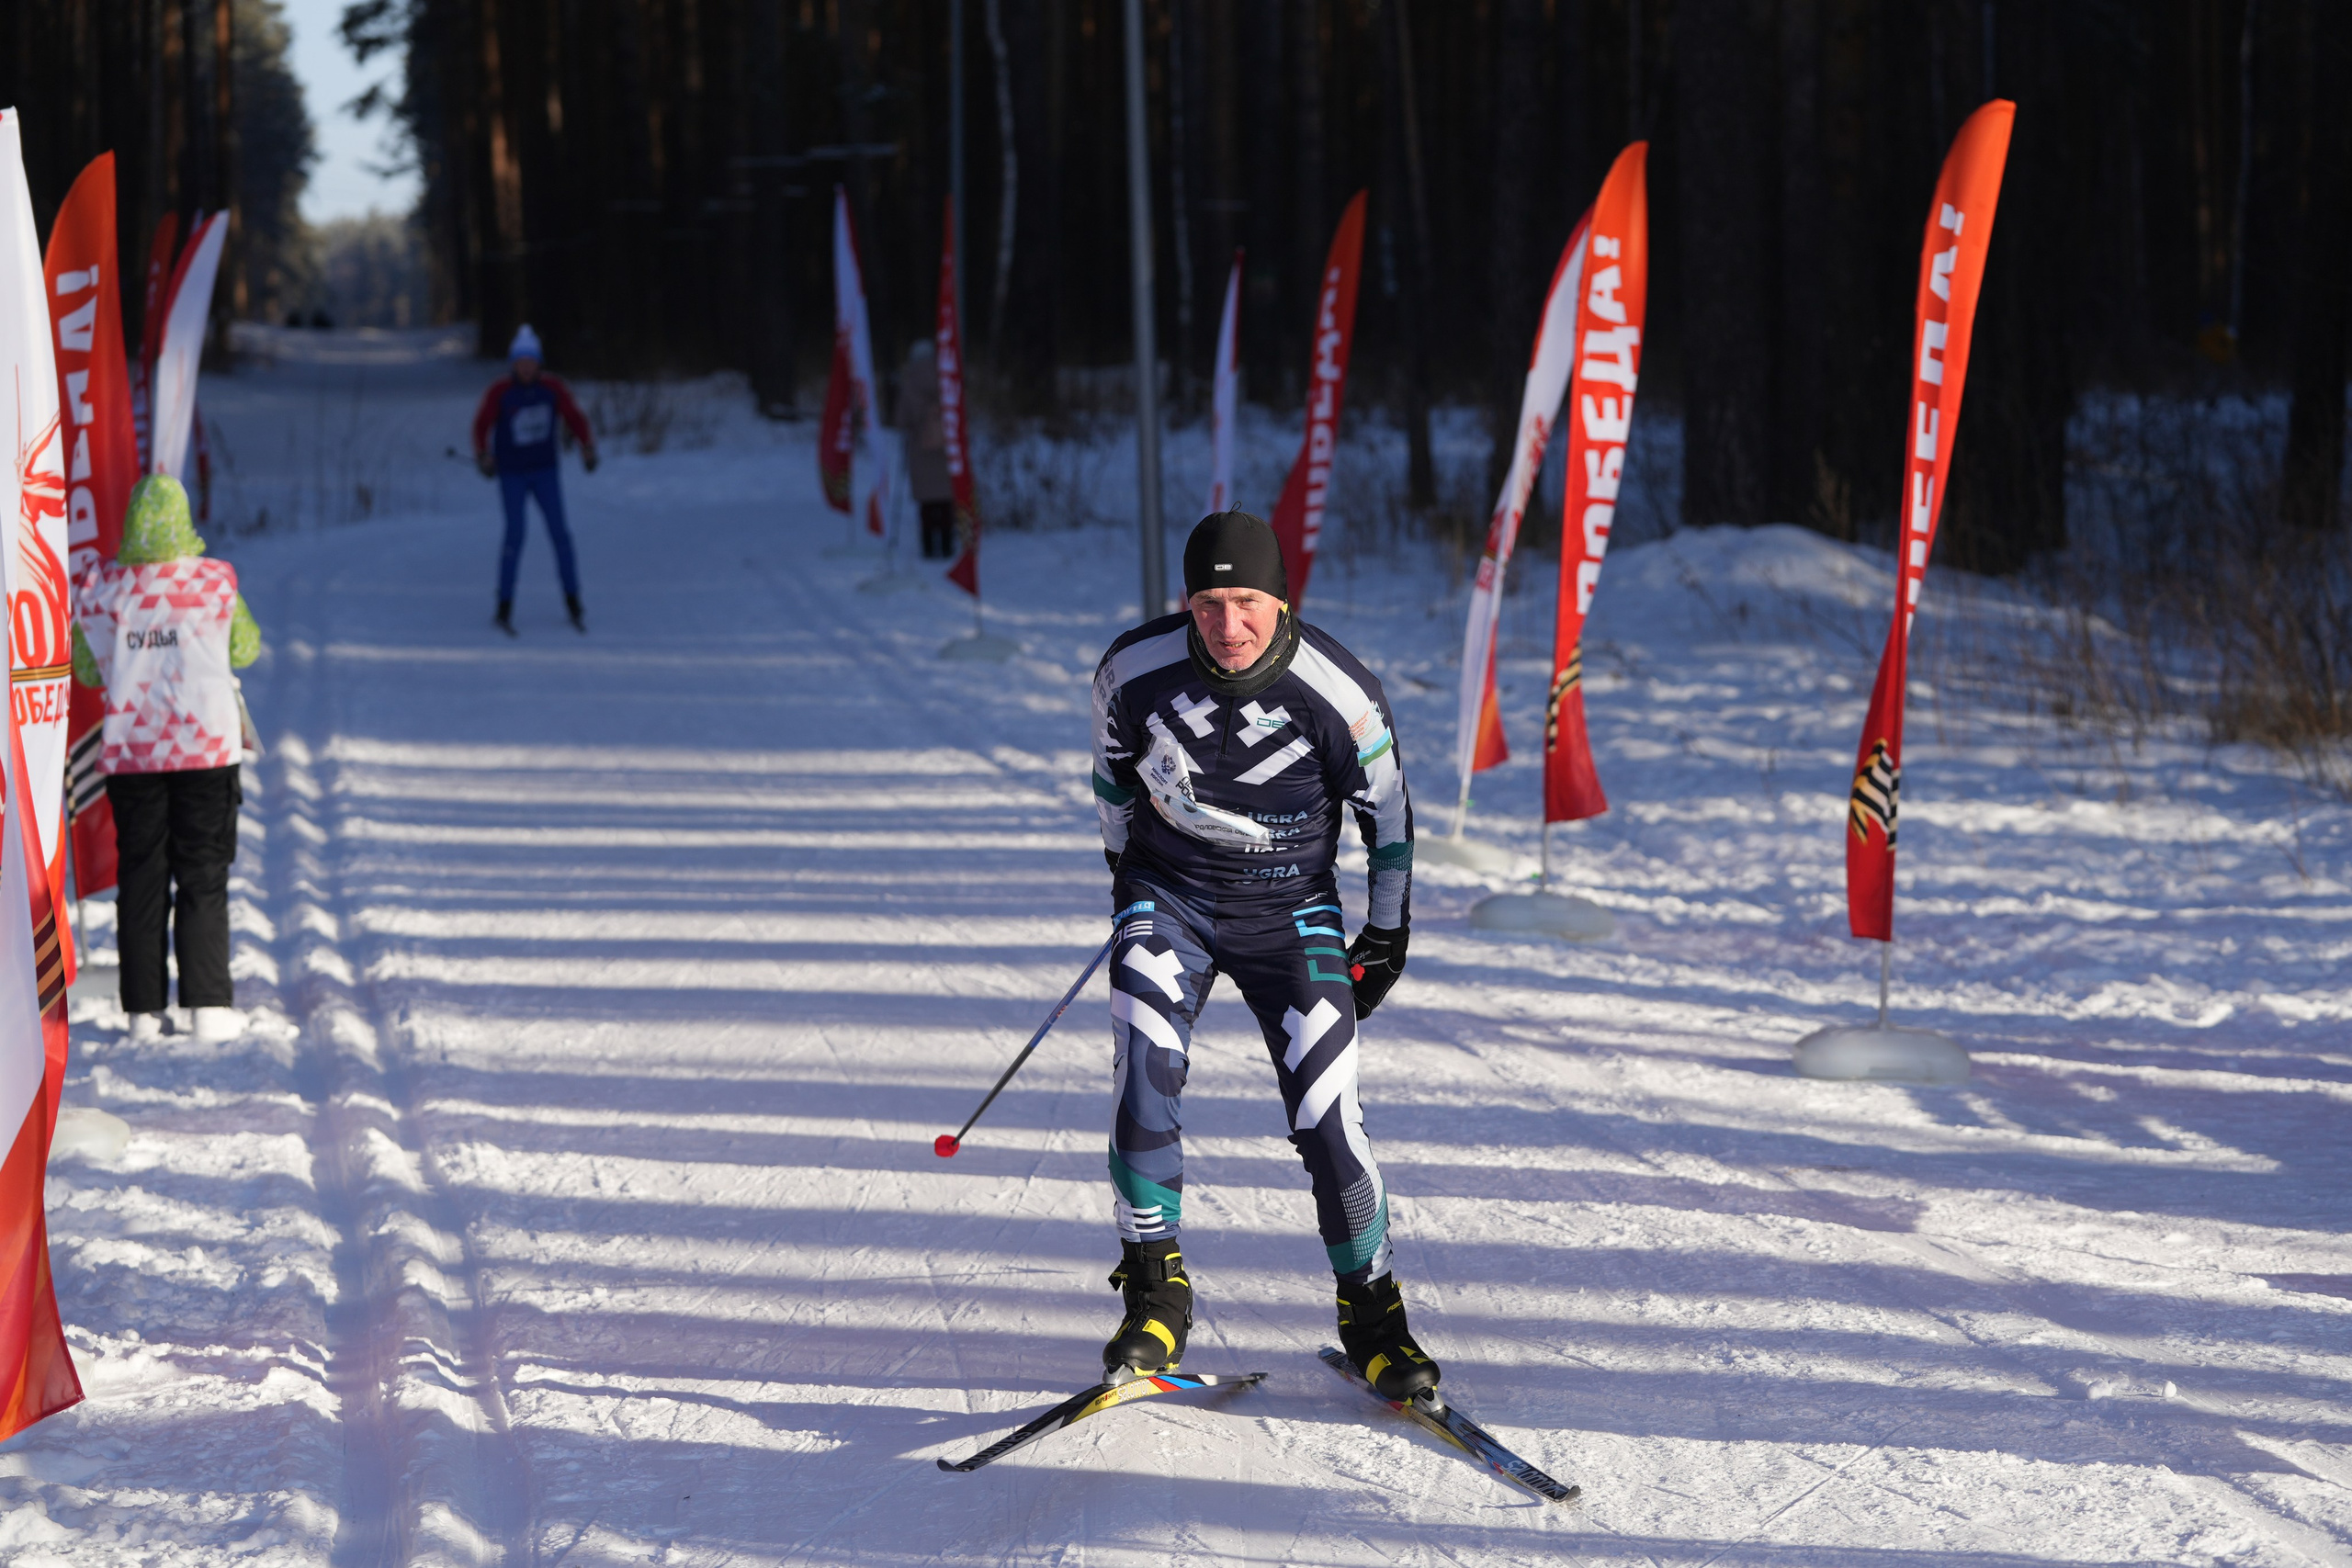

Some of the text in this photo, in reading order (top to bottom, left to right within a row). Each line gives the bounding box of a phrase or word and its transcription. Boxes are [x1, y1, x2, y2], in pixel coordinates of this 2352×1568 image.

[127, 629, 178, 649] СУДЬЯ
[14, 681, 71, 730] ОБЕД
[1248, 810, 1308, 824] UGRA
[1243, 863, 1300, 880] UGRA
